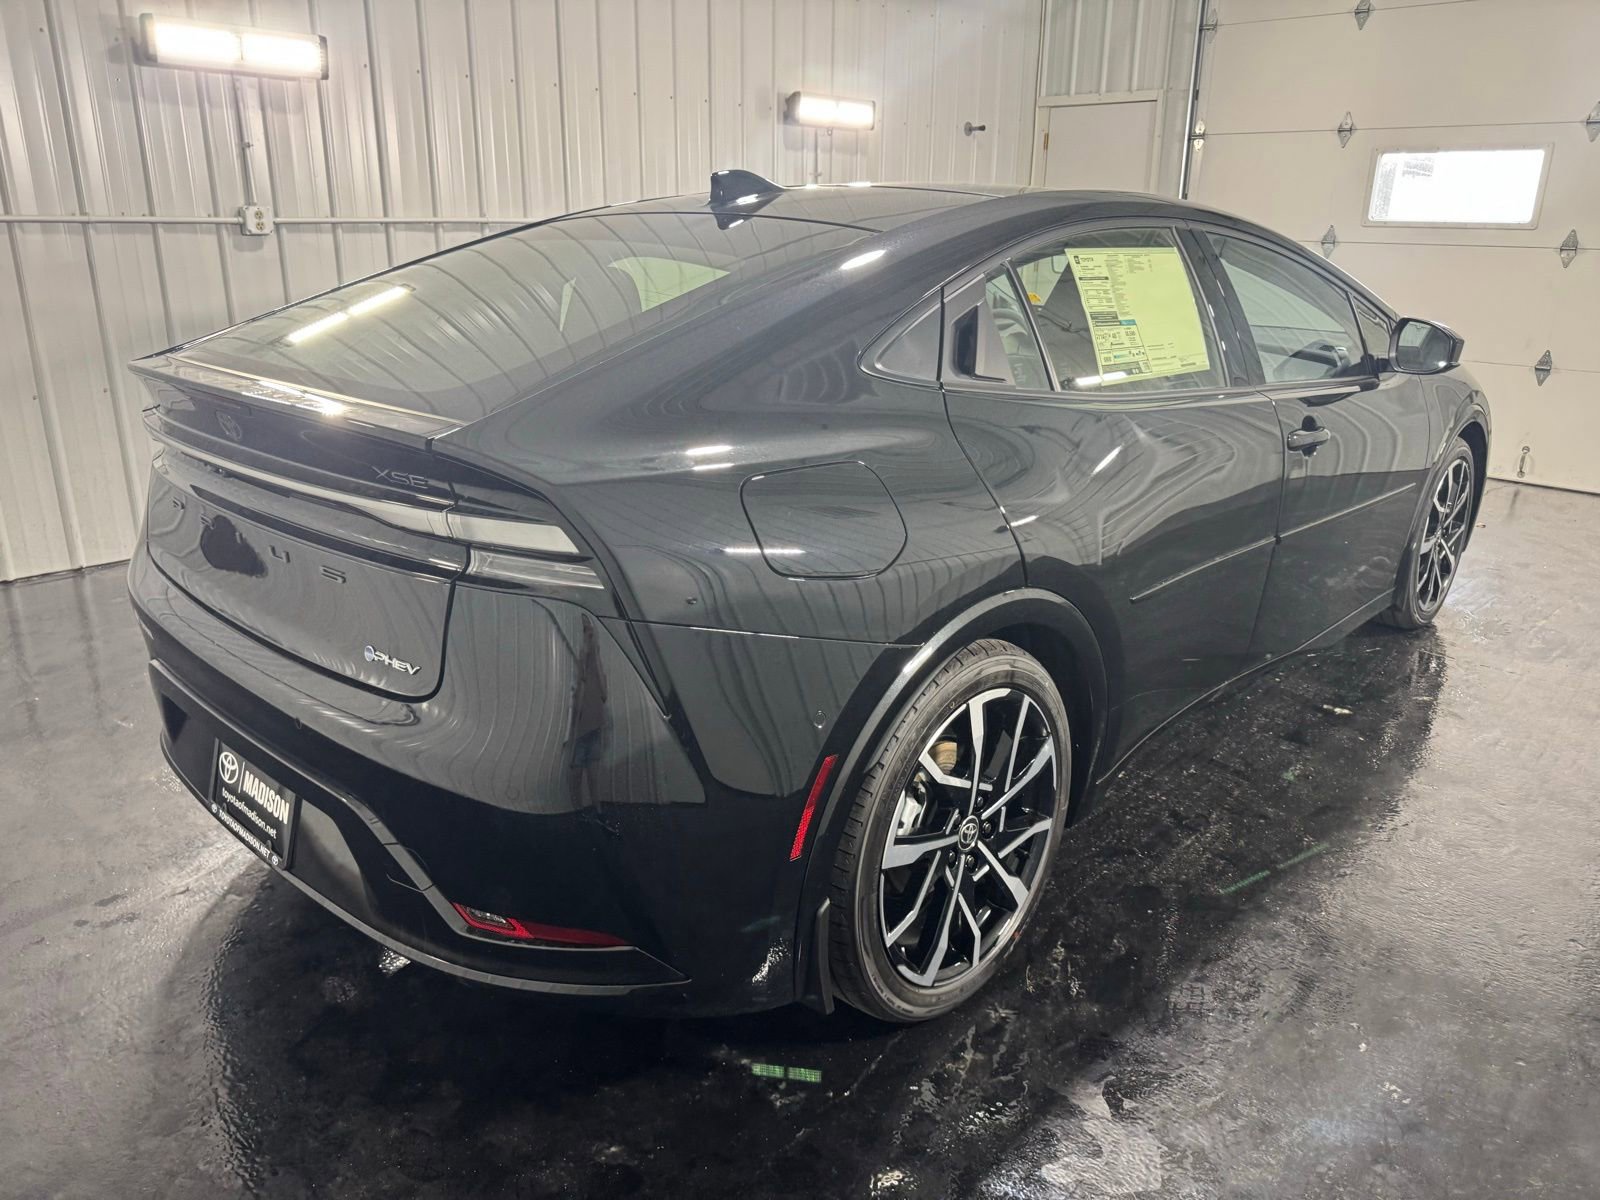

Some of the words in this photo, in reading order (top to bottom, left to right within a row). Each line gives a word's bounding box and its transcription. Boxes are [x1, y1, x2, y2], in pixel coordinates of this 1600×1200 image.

[371, 464, 429, 489] XSE
[373, 650, 421, 676] PHEV
[222, 787, 277, 839] toyotaofmadison.net
[243, 770, 290, 824] MADISON
[219, 809, 271, 859] TOYOTAOFMADISON.NET
